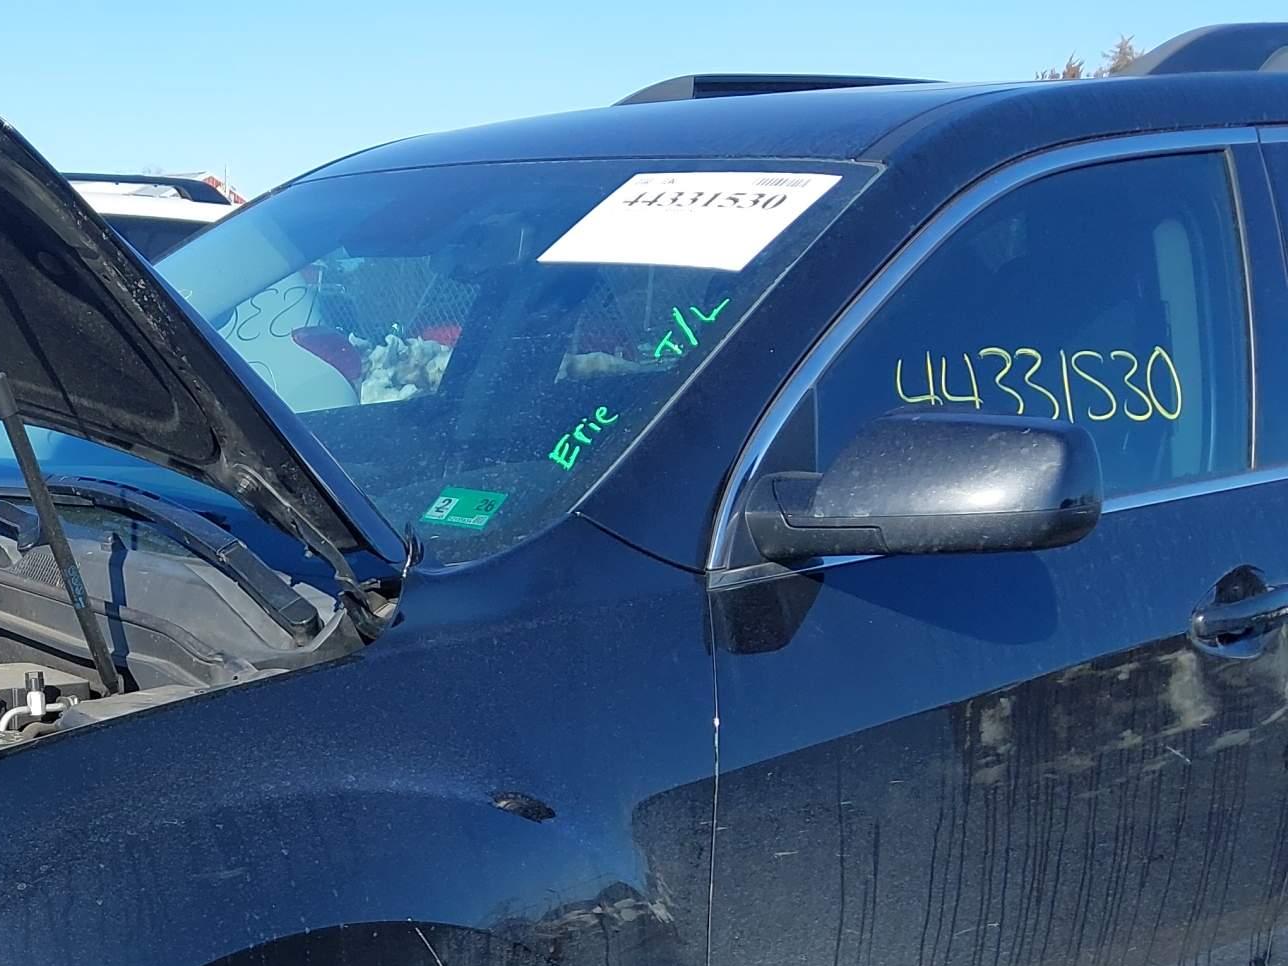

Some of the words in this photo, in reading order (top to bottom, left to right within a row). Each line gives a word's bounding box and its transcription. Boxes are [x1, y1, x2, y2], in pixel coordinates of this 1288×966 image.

[622, 191, 788, 210] 44331530
[896, 346, 1182, 424] 44331530
[548, 406, 619, 471] Erie
[476, 499, 496, 513] 26
